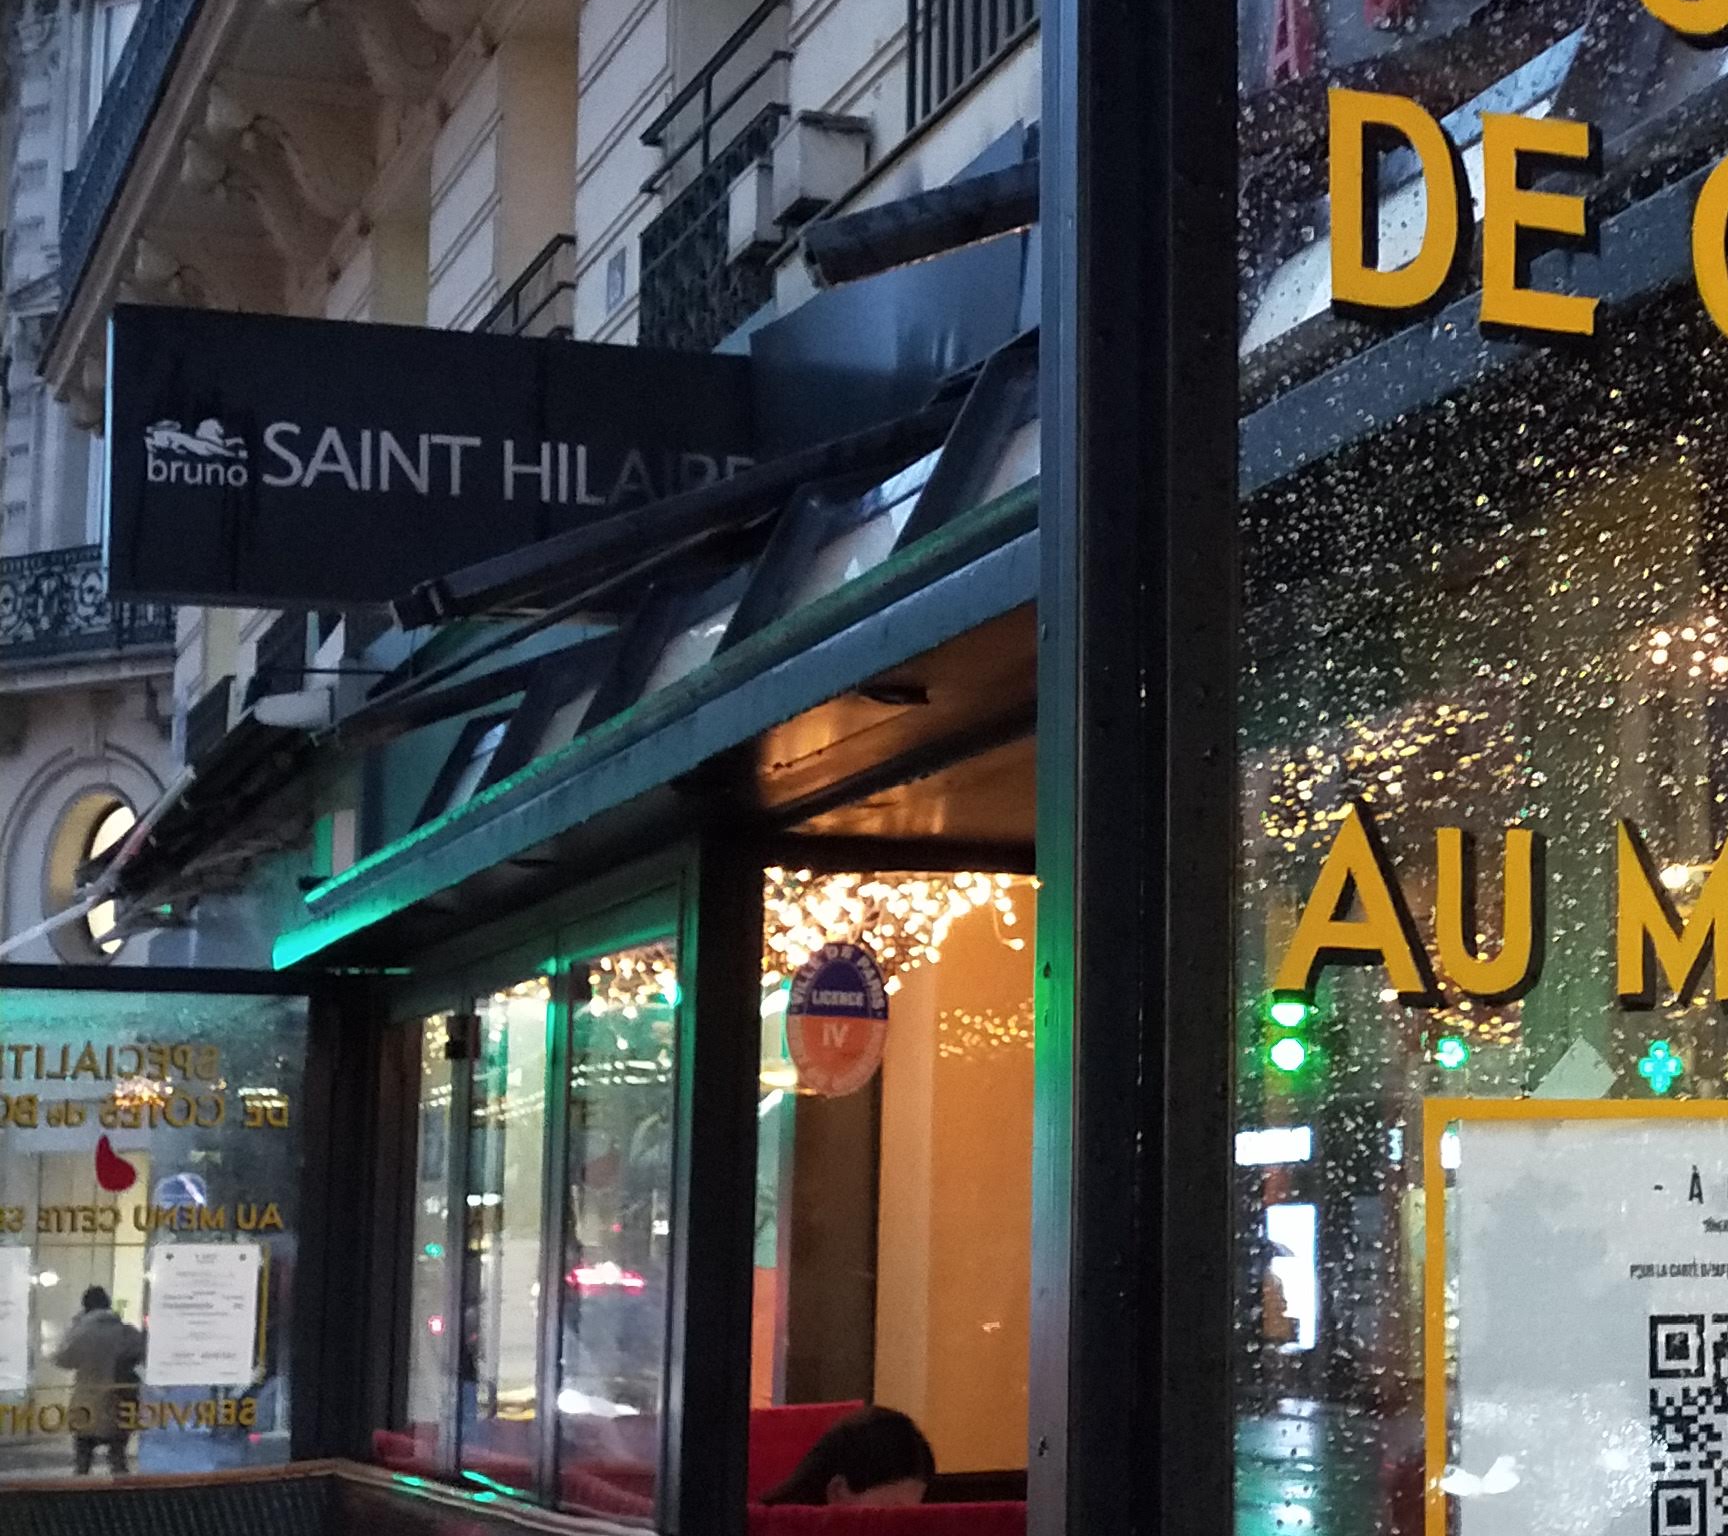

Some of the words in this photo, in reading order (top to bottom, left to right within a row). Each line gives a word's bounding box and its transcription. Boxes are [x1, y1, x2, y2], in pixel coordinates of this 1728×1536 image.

[1327, 87, 1601, 341] DE
[146, 455, 248, 488] bruno
[262, 421, 481, 496] SAINT
[1272, 806, 1535, 997] AU
[822, 1022, 850, 1048] IV
